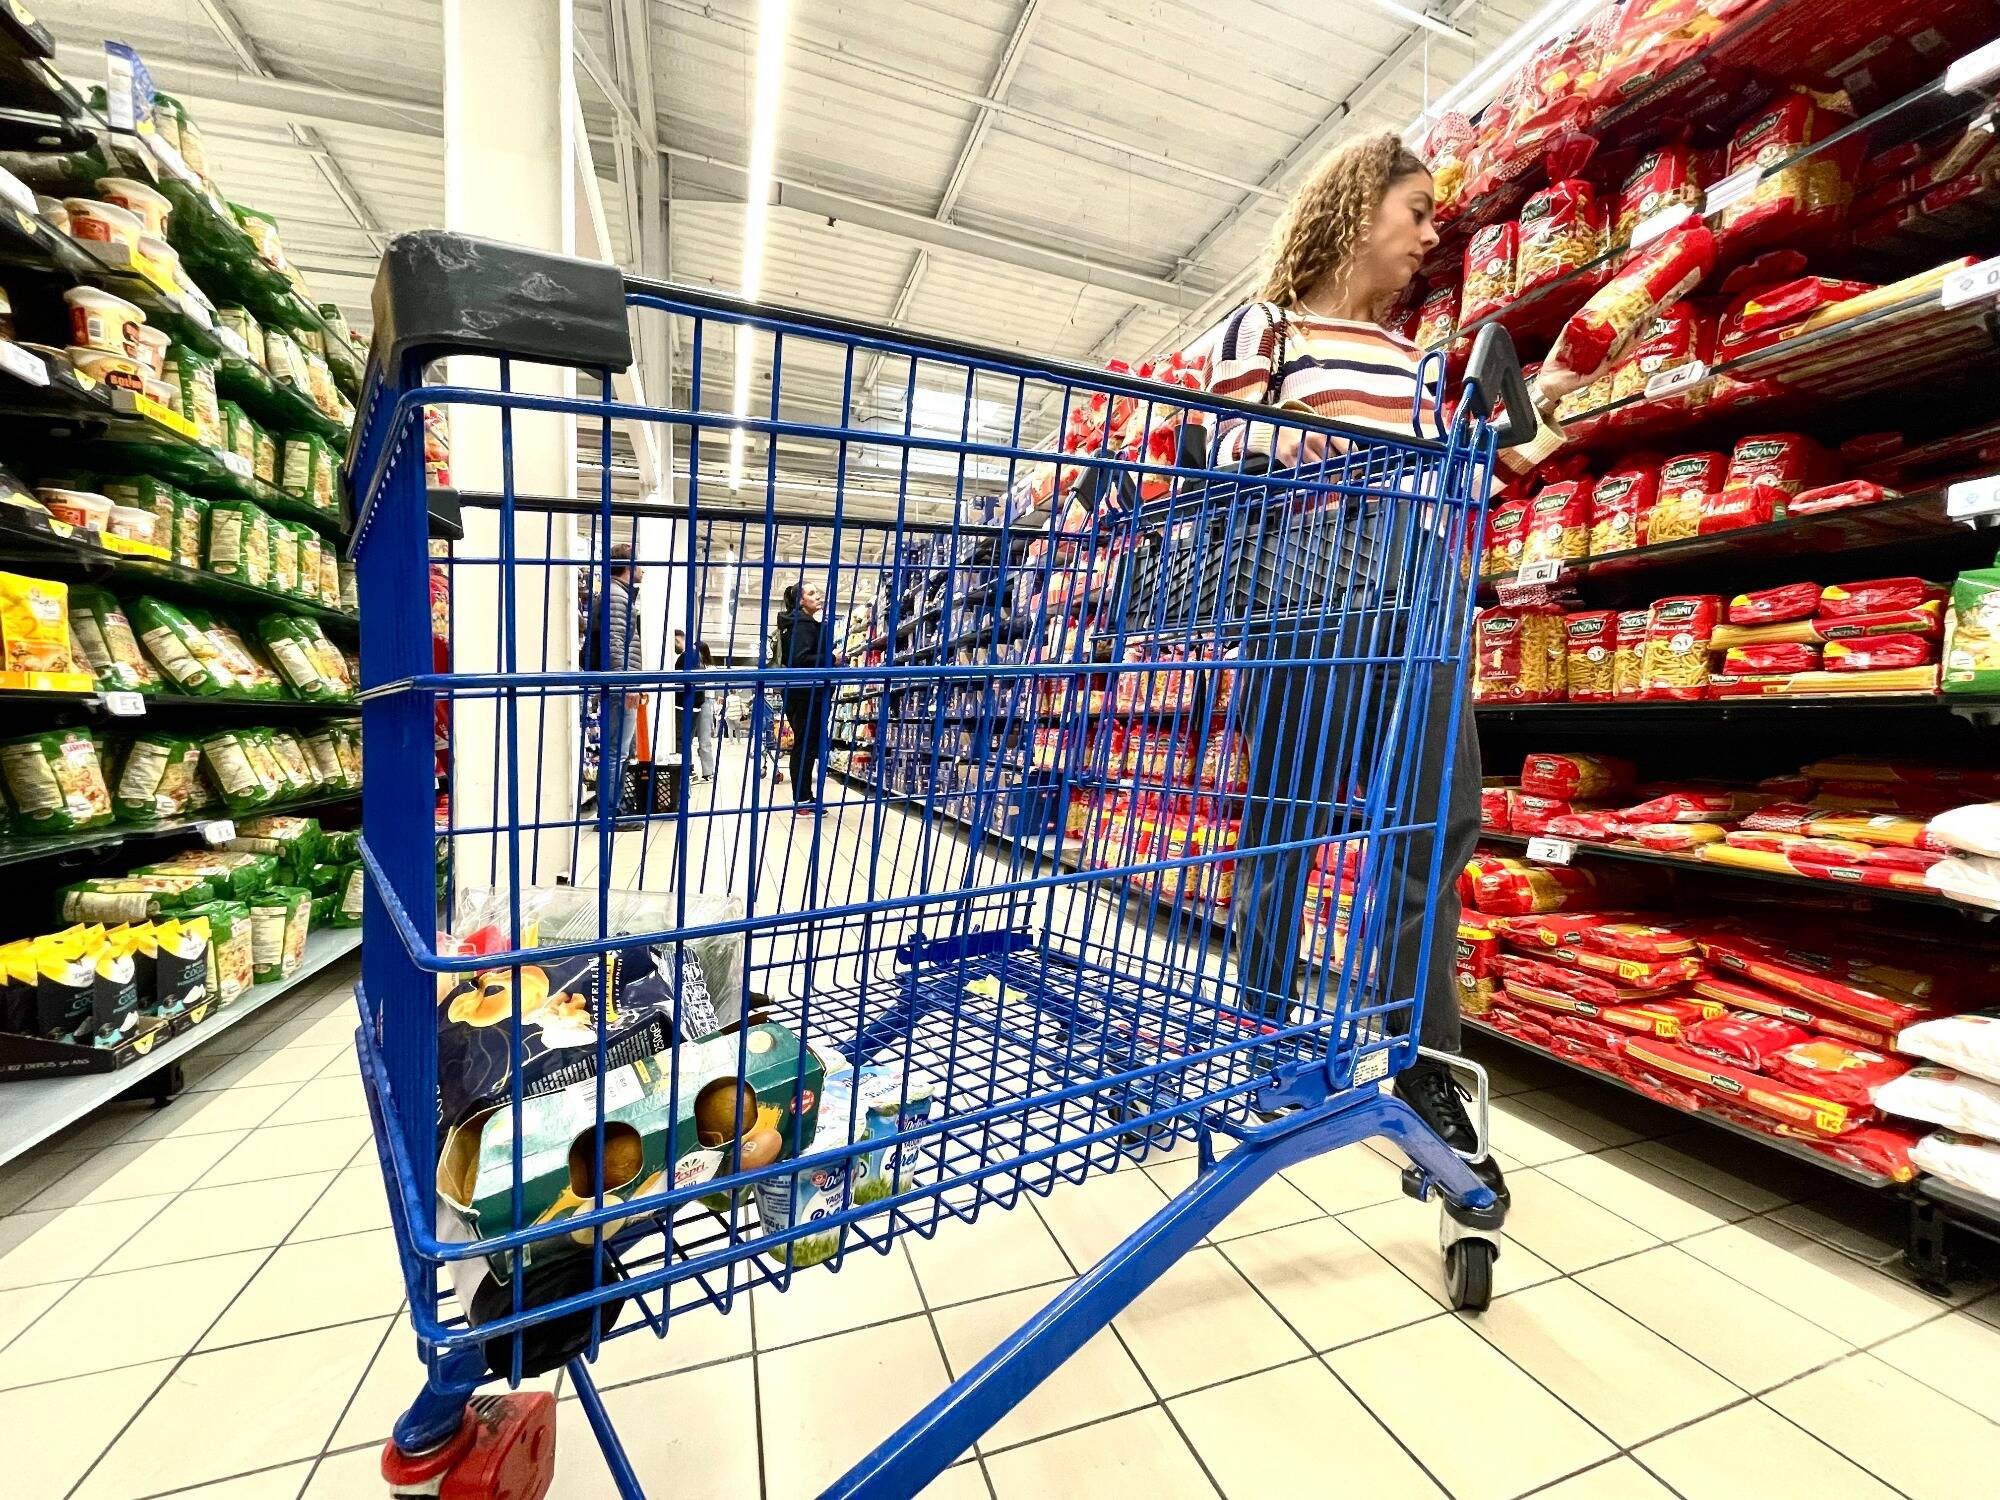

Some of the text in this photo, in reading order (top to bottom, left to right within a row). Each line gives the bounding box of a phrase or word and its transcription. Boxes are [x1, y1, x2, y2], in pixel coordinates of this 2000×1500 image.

[1737, 445, 1779, 461] PANZANI
[1666, 462, 1702, 479] PANZANI
[1571, 623, 1601, 634] PANZANI
[1619, 617, 1647, 629] PANZAN
